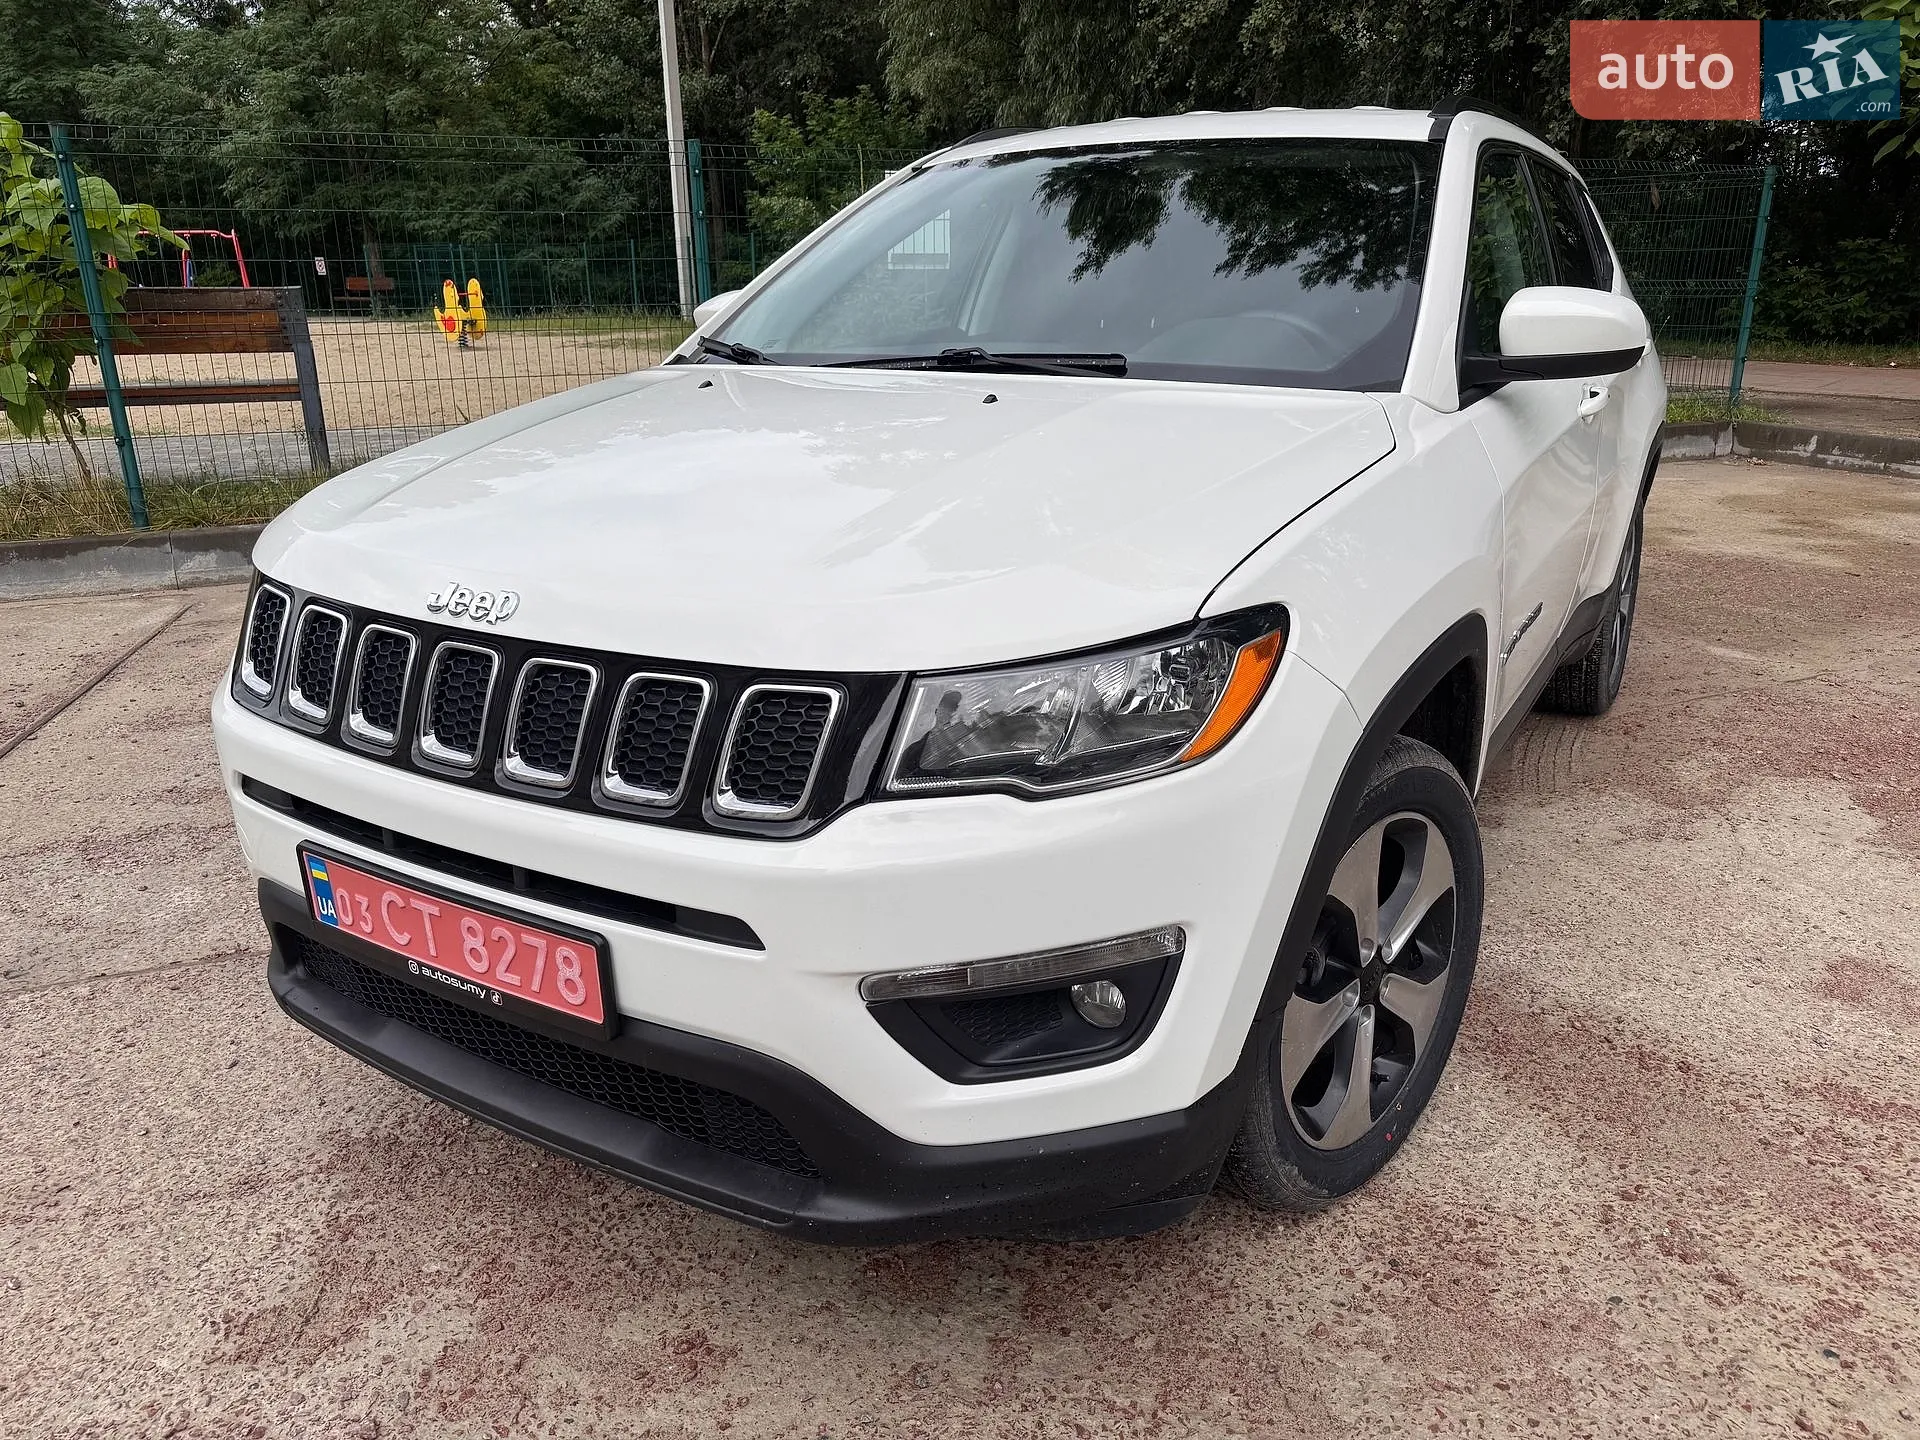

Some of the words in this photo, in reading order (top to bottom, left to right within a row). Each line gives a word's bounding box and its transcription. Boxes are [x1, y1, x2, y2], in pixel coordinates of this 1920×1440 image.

[426, 581, 520, 626] Jeep
[317, 896, 337, 918] UA
[336, 888, 373, 934] 03
[381, 891, 441, 957] CT
[460, 917, 587, 1006] 8278
[421, 967, 486, 999] autosumy
